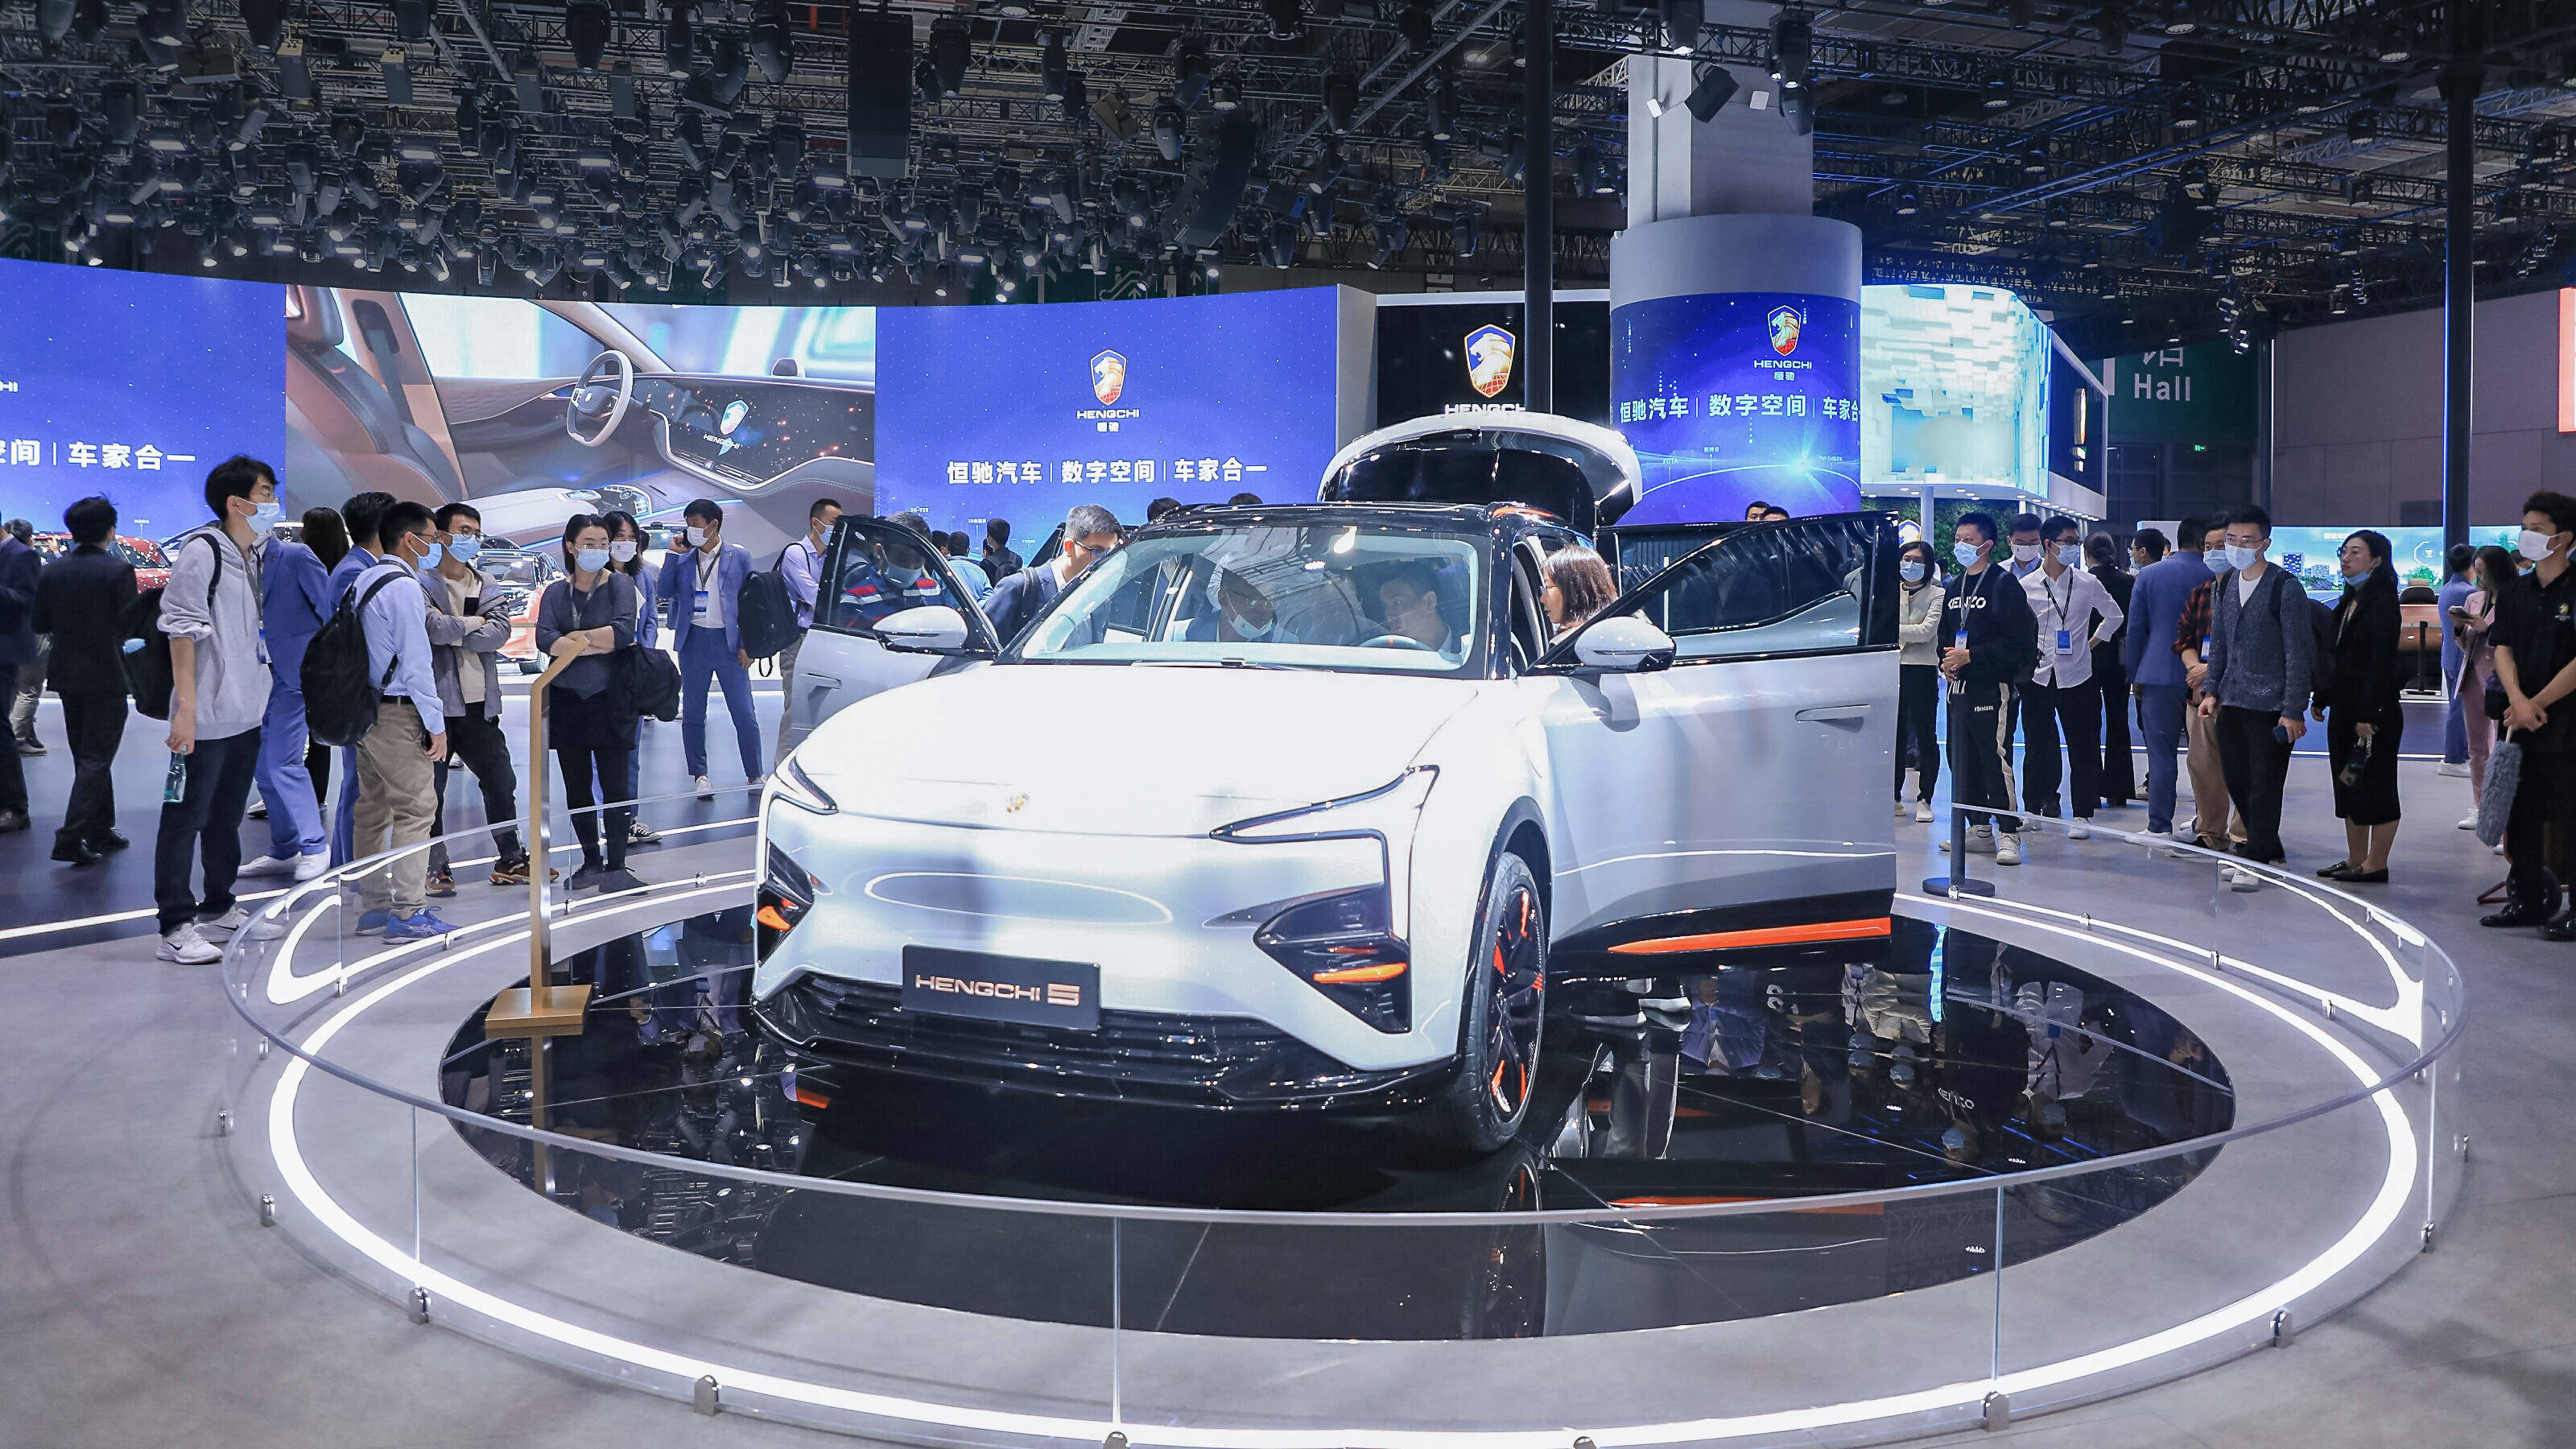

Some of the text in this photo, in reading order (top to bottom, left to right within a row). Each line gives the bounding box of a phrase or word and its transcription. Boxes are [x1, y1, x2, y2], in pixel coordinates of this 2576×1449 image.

[1753, 360, 1812, 369] HENGCHI
[2134, 373, 2190, 402] Hall
[1076, 409, 1140, 419] HENGCHI
[1620, 393, 1860, 424] 恒驰汽车 数字空间 车家合
[68, 441, 196, 471] 车家合一
[946, 456, 1268, 485] 恒驰汽车 数字空间 车家合一
[915, 974, 1081, 1006] HENGCHI 5
